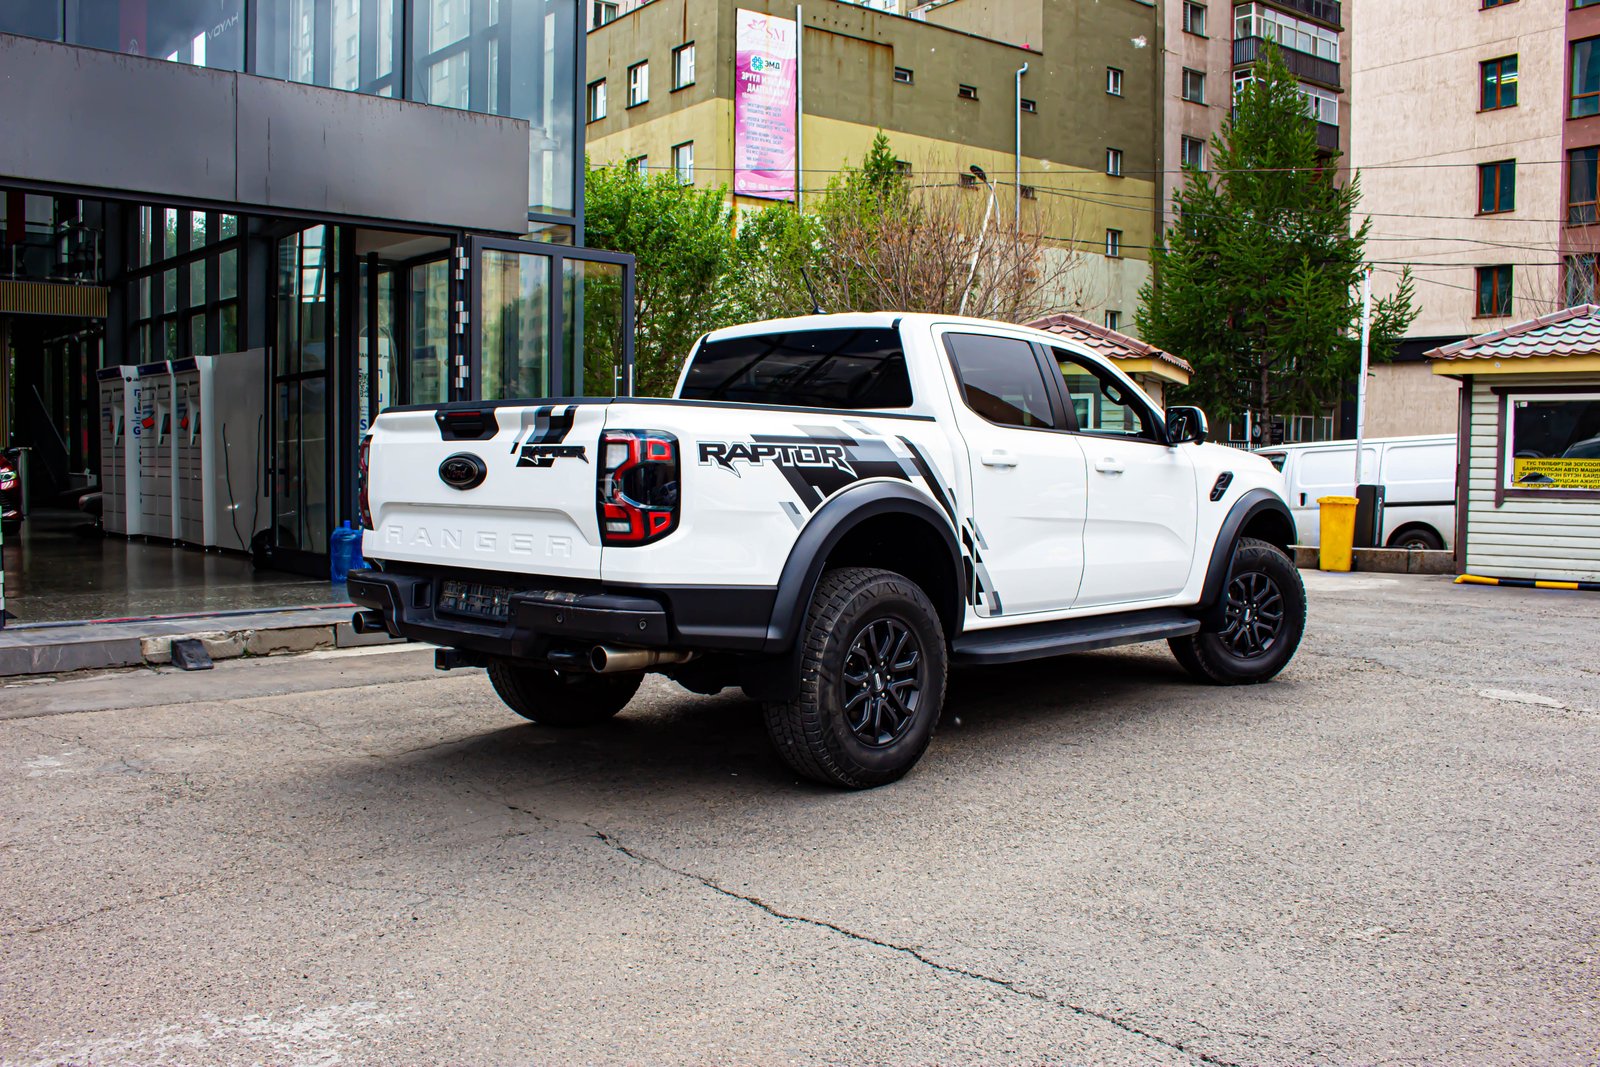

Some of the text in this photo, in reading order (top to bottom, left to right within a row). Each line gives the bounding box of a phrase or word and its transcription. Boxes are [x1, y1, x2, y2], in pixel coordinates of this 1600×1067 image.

[207, 12, 239, 41] VOYAH
[764, 61, 781, 70] ЭМД
[695, 440, 858, 478] RAPTOR
[385, 524, 575, 558] RANGER
